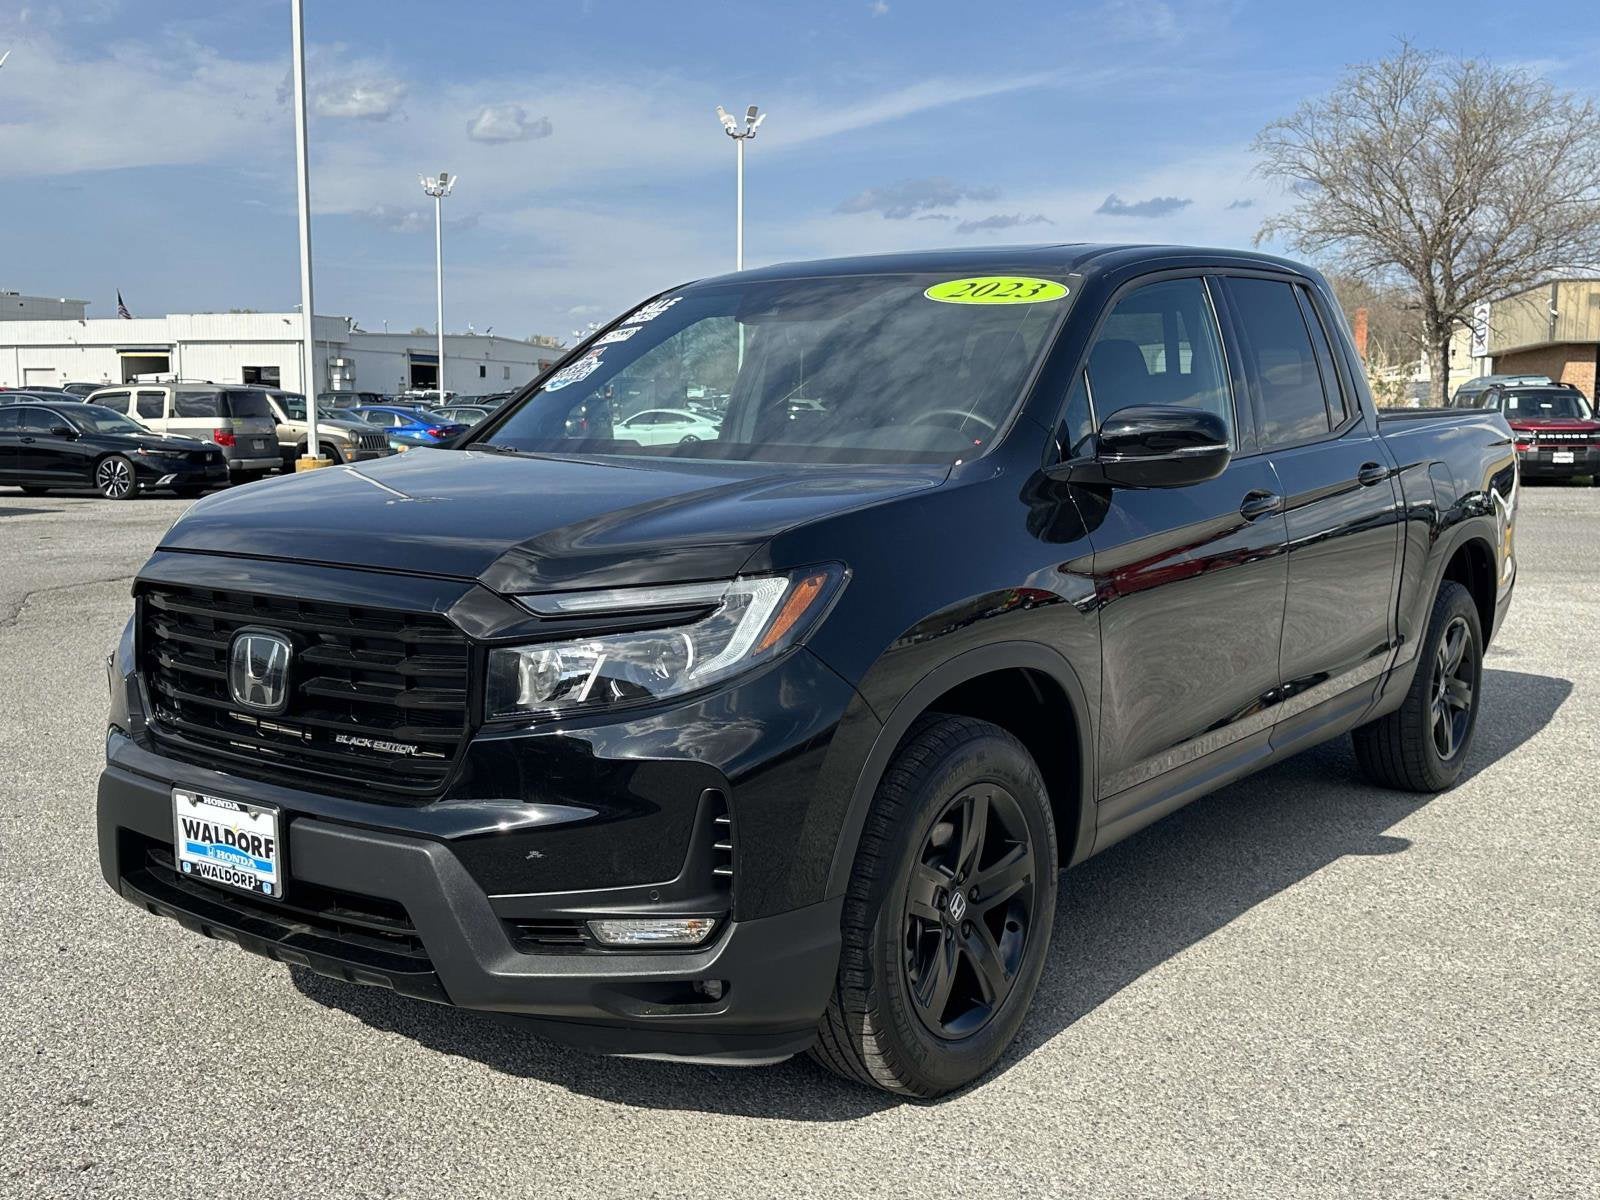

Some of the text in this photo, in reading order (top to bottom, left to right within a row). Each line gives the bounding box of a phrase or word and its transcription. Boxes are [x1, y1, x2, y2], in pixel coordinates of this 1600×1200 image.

[944, 281, 1048, 298] 2023
[335, 734, 419, 755] BLACK EDITION
[202, 796, 241, 811] HONDA
[181, 817, 275, 859] WALDORF
[216, 849, 257, 868] HONDA
[199, 862, 256, 889] WALDORF
